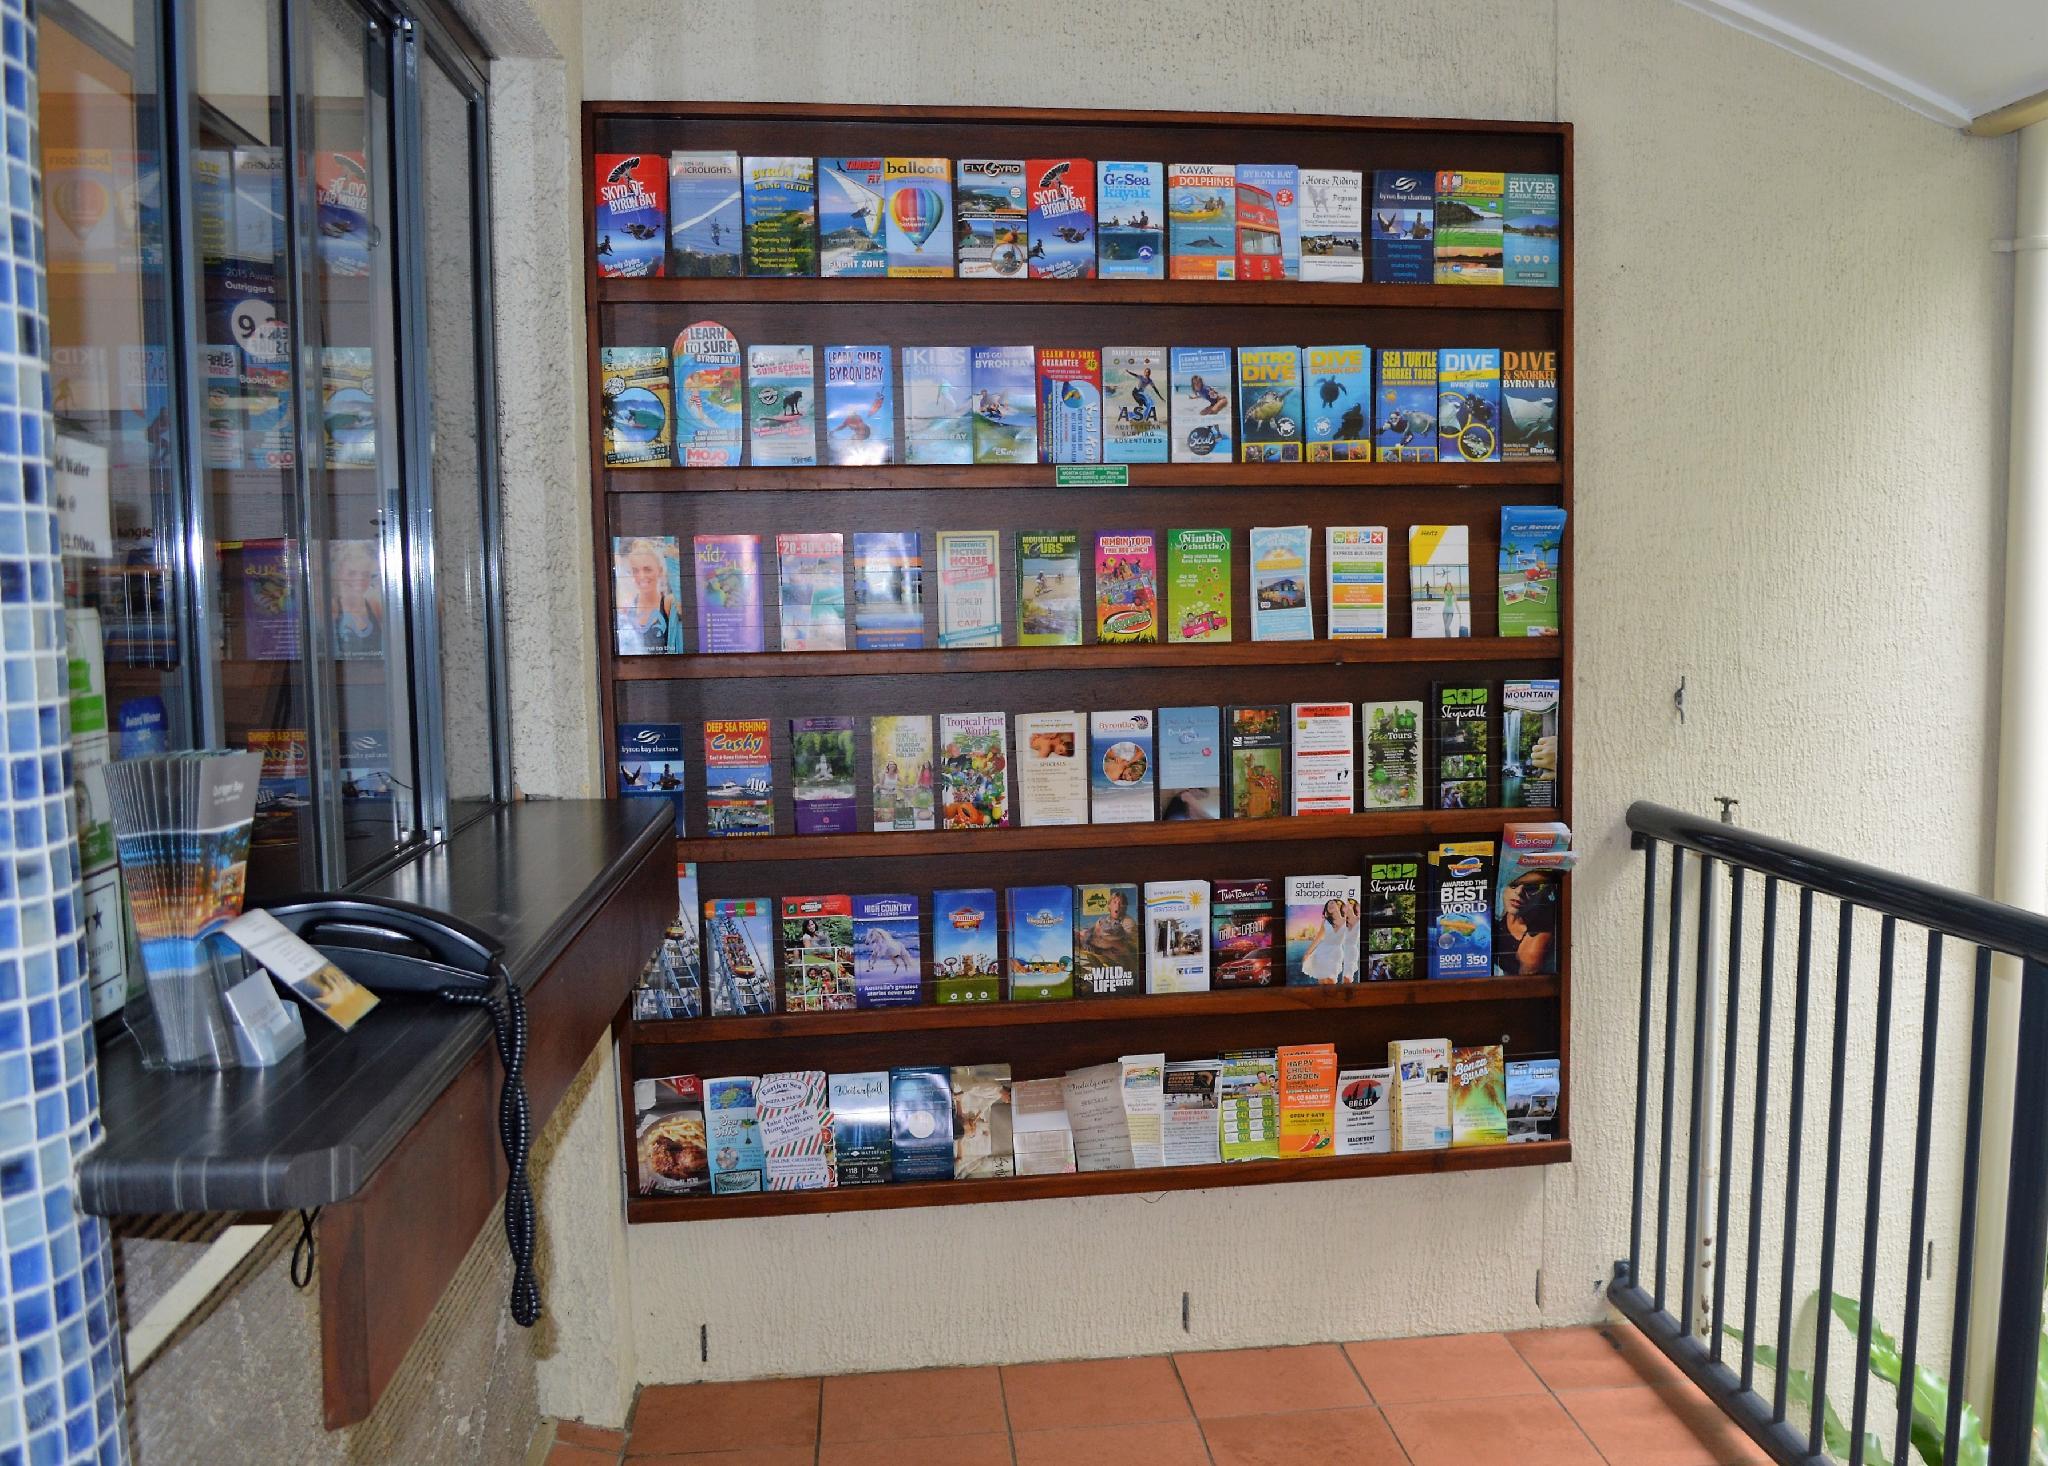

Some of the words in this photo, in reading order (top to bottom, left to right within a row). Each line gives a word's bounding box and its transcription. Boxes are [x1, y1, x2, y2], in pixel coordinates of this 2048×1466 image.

[887, 161, 945, 174] balloon
[1179, 166, 1214, 175] KAYAK
[867, 174, 881, 184] FLY
[1302, 175, 1330, 186] Horse
[1332, 175, 1359, 189] Riding
[1104, 186, 1150, 201] kayak
[1509, 181, 1556, 194] RIVER
[609, 195, 636, 213] BYRON
[636, 191, 657, 207] BAY
[1379, 192, 1396, 201] byron
[1408, 193, 1432, 201] charters
[1041, 202, 1066, 218] BYRON
[1067, 197, 1087, 213] BAY
[861, 260, 885, 269] ZONE
[224, 280, 267, 294] Outrigger
[690, 327, 725, 340] LEARN
[703, 340, 733, 354] SURF
[696, 354, 720, 363] BYRON
[857, 351, 883, 364] SURF
[1042, 351, 1066, 359] LEARN
[1068, 351, 1078, 359] TO
[1079, 351, 1096, 359] SURF
[1241, 351, 1296, 365] INTRO
[1311, 350, 1362, 366] DIVE
[1382, 351, 1401, 368] SEA
[1403, 351, 1437, 368] TURTLE
[1503, 351, 1556, 370] DIVE
[975, 360, 1010, 369] BYRON
[1012, 359, 1033, 368] BAY
[1041, 358, 1079, 368] GUARANTEE
[1445, 354, 1493, 371] DIVE
[829, 366, 862, 381] BYRON
[864, 366, 884, 381] BAY
[1242, 365, 1296, 381] DIVE
[1382, 367, 1413, 379] SNORKEL
[1414, 367, 1437, 379] TOURS
[1512, 370, 1555, 380] SNORKEL
[1503, 379, 1536, 388] BYRON
[1538, 379, 1556, 388] BAY
[1117, 405, 1159, 422] ASA
[1059, 535, 1076, 543] BIKE
[1101, 537, 1130, 546] NIMBIN
[1131, 537, 1152, 546] TOUR
[1182, 533, 1224, 543] Nimbin
[950, 548, 987, 556] PICTURE
[1023, 543, 1064, 554] TOURS
[950, 556, 988, 567] HOUSE
[1505, 691, 1554, 699] MOUNTAIN
[1441, 705, 1487, 727] Skywalk
[707, 722, 723, 733] DEEP
[724, 722, 738, 732] SEA
[738, 721, 768, 732] FISHING
[946, 717, 981, 729] Tropical
[983, 716, 1004, 727] Fruit
[965, 725, 990, 736] World
[652, 745, 679, 753] charters
[1295, 881, 1325, 889] outlet
[1370, 880, 1416, 900] Skywalk
[1442, 880, 1474, 888] AWARDED
[1217, 888, 1235, 901] Twin
[1295, 889, 1343, 899] shopping
[1440, 886, 1488, 903] BEST
[864, 904, 879, 913] HIGH
[880, 903, 912, 912] COUNTRY
[1440, 903, 1488, 915] WORLD
[1466, 955, 1488, 965] 350
[1092, 966, 1123, 980] WILD
[1093, 979, 1117, 993] LIFE
[1287, 1059, 1314, 1067] HAPPY
[1286, 1073, 1319, 1081] GARDEN
